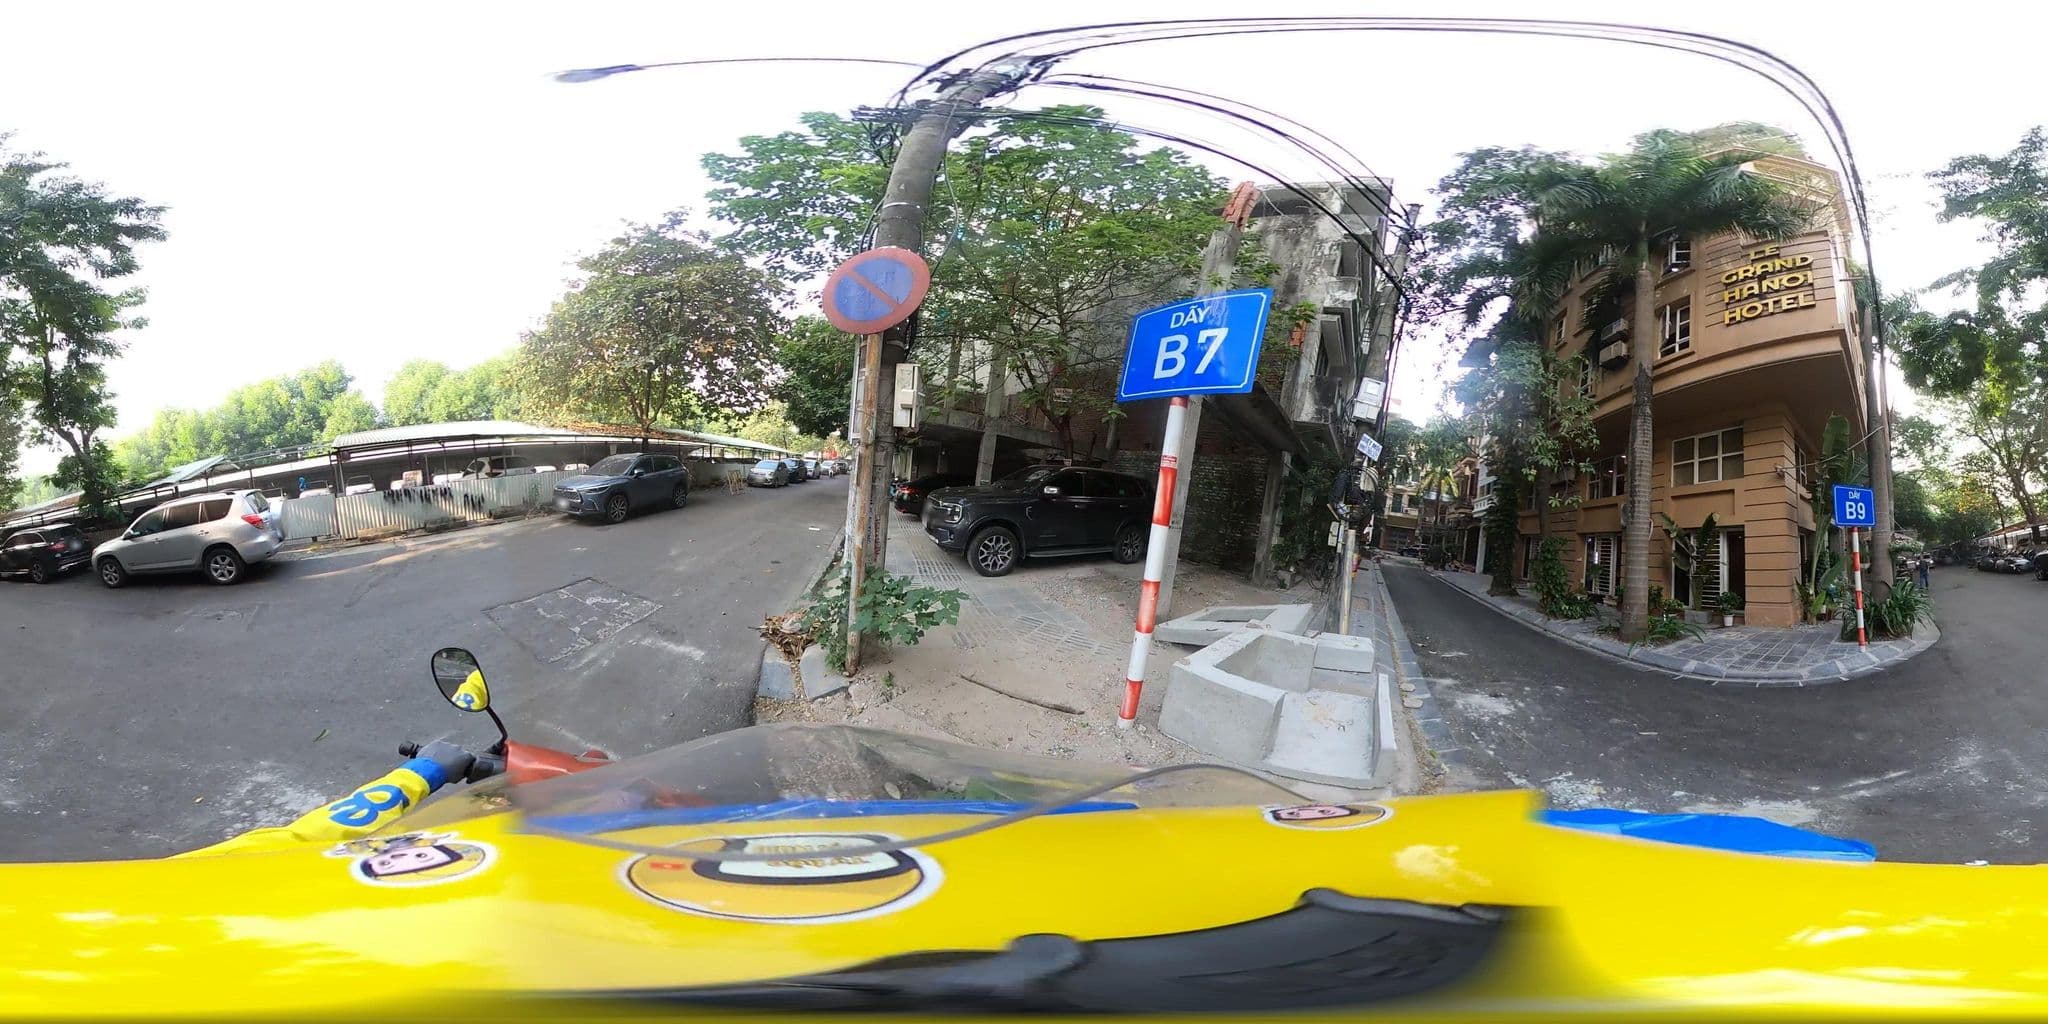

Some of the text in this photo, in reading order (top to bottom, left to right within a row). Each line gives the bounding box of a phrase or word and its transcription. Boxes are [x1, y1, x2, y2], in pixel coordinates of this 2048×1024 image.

[1747, 244, 1780, 260] LE
[1721, 254, 1814, 284] GRAND
[1723, 270, 1814, 303] HANOI
[1170, 304, 1210, 329] DÃY
[1724, 292, 1816, 325] HOTEL
[1153, 327, 1229, 380] B7
[1845, 501, 1866, 520] B9
